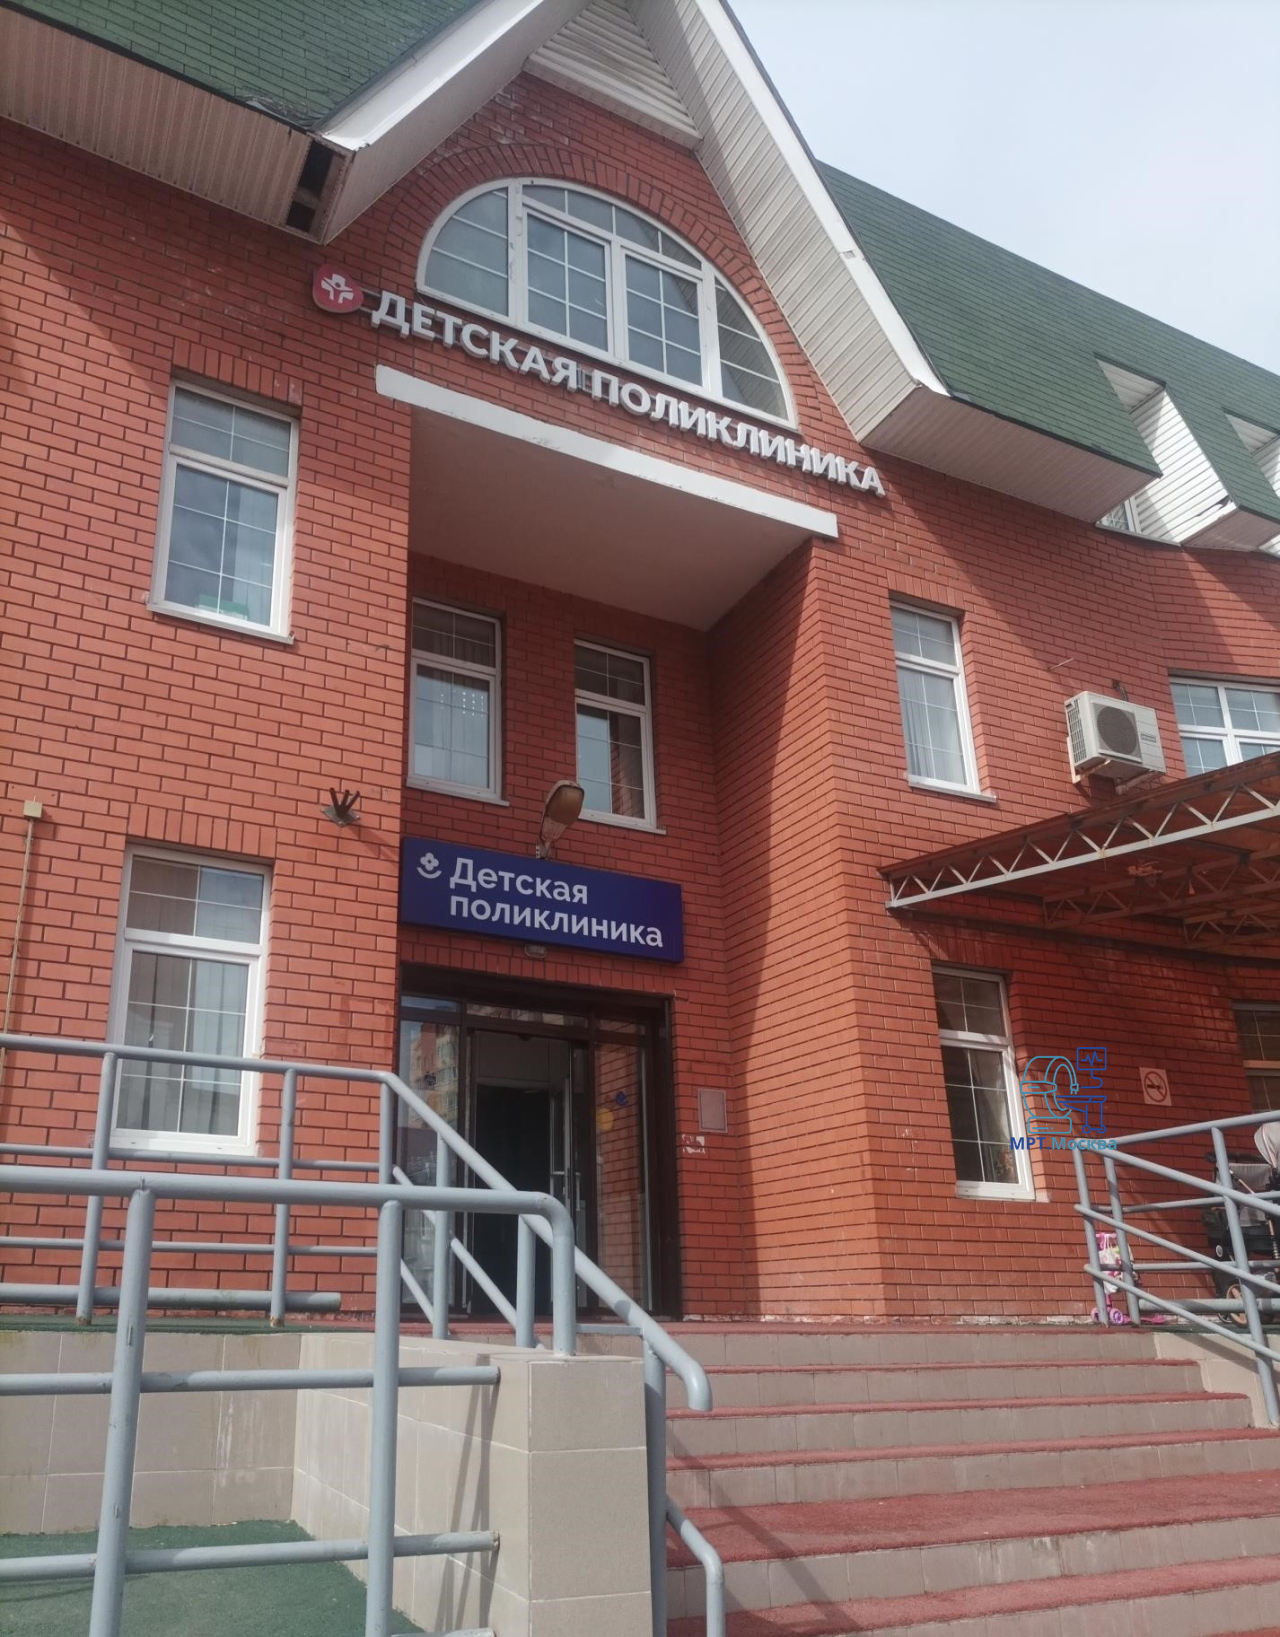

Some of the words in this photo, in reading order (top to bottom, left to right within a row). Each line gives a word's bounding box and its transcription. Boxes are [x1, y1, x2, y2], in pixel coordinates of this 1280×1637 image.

[370, 289, 578, 393] ДЕТСКАЯ
[591, 369, 886, 498] ПОЛИКЛИНИКА
[450, 857, 588, 904] Детская
[450, 895, 663, 947] поликлиника
